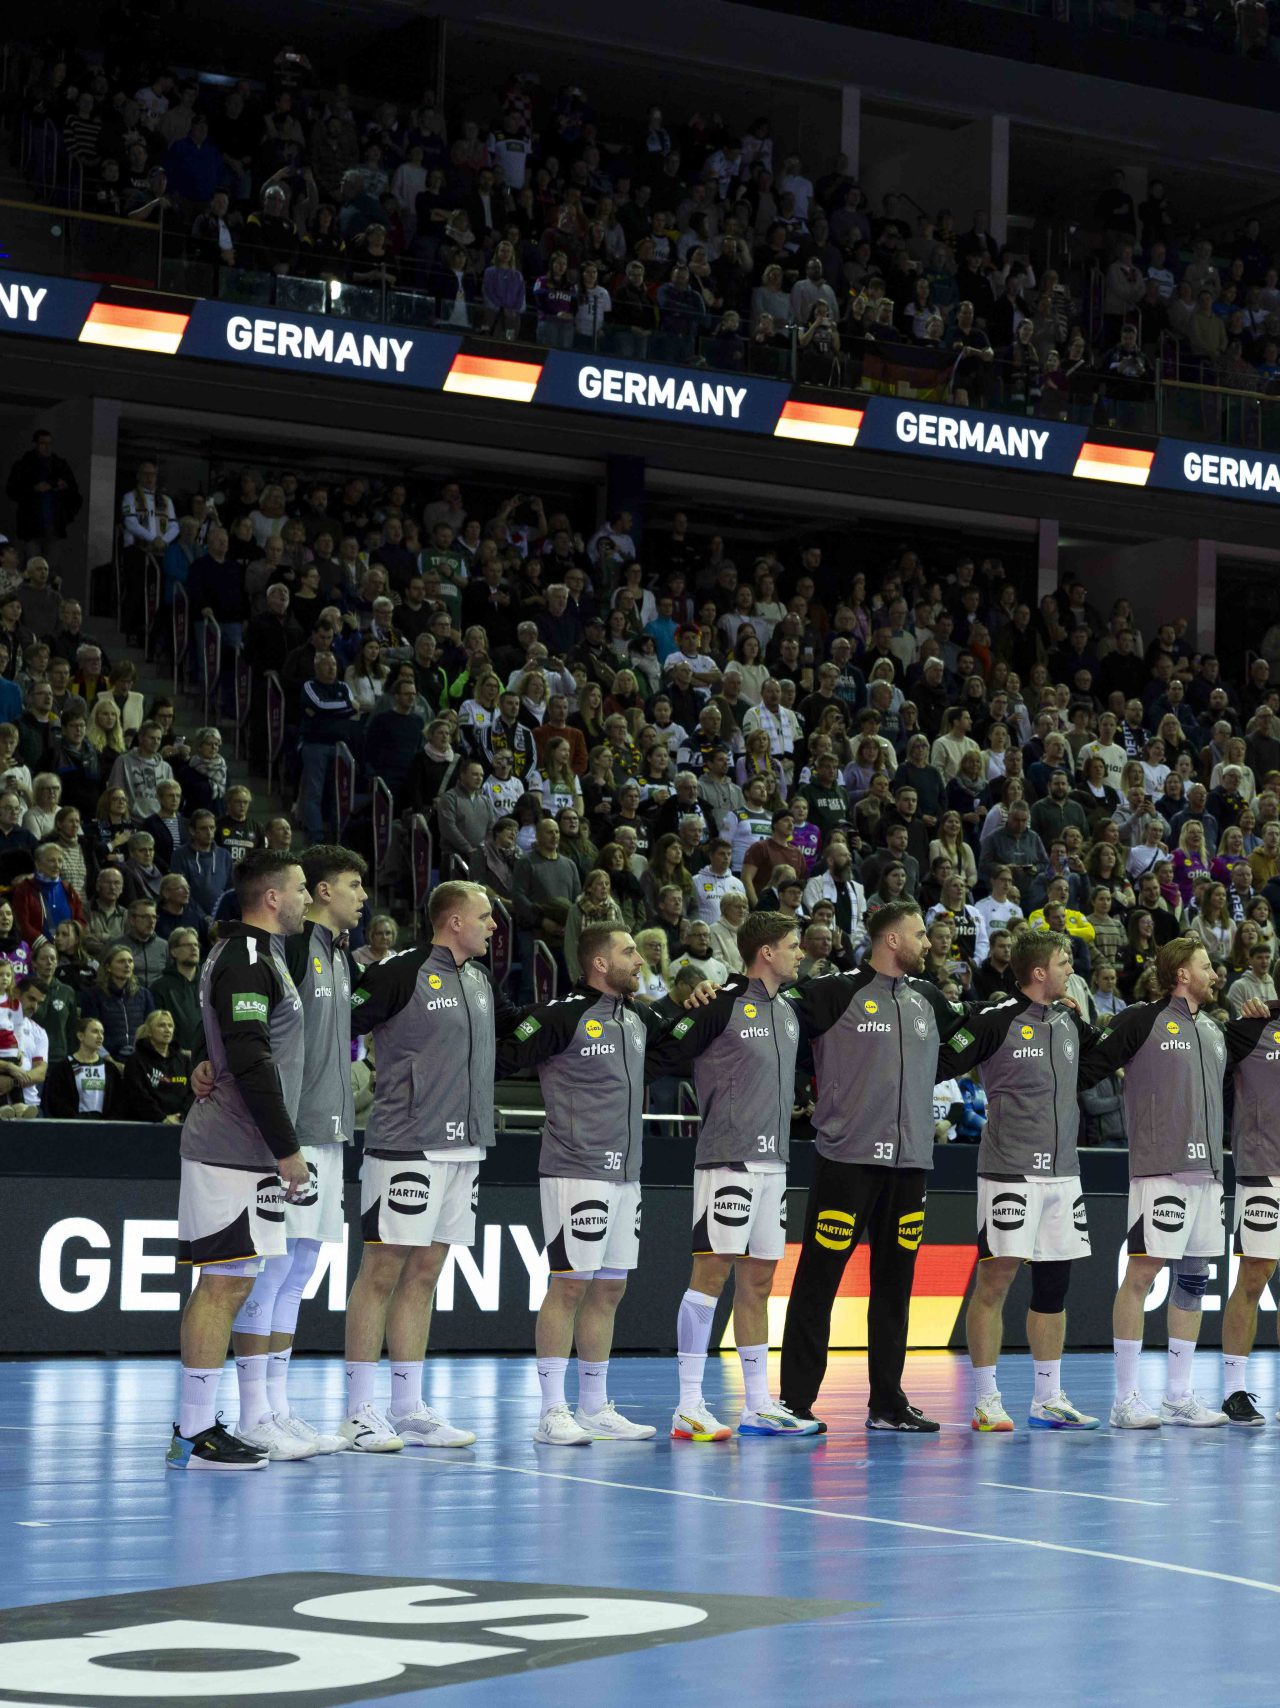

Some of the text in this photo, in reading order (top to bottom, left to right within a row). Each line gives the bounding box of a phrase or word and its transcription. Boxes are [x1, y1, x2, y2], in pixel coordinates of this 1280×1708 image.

[227, 316, 413, 372] GERMANY
[579, 366, 747, 418] GERMANY
[897, 412, 1049, 459] GERMANY
[315, 986, 331, 997] atlas
[235, 1000, 267, 1014] ALSCO
[427, 997, 458, 1010] atlas
[740, 1027, 769, 1038] atlas
[857, 1021, 891, 1032] atlas
[581, 1043, 615, 1056] atlas
[1161, 1040, 1191, 1050] atlas
[1013, 1047, 1043, 1058] atlas
[446, 1122, 464, 1140] 54
[757, 1136, 775, 1153] 34
[874, 1142, 893, 1159] 33
[1187, 1143, 1206, 1159] 30
[604, 1152, 622, 1170] 36
[1033, 1153, 1051, 1169] 32
[388, 1187, 430, 1200] HARTING
[714, 1201, 751, 1212] HARTING
[992, 1207, 1026, 1217] HARTING
[1152, 1209, 1185, 1220] HARTING
[1244, 1208, 1279, 1219] HARTING
[571, 1216, 608, 1227] HARTING
[816, 1221, 853, 1238] HARTING
